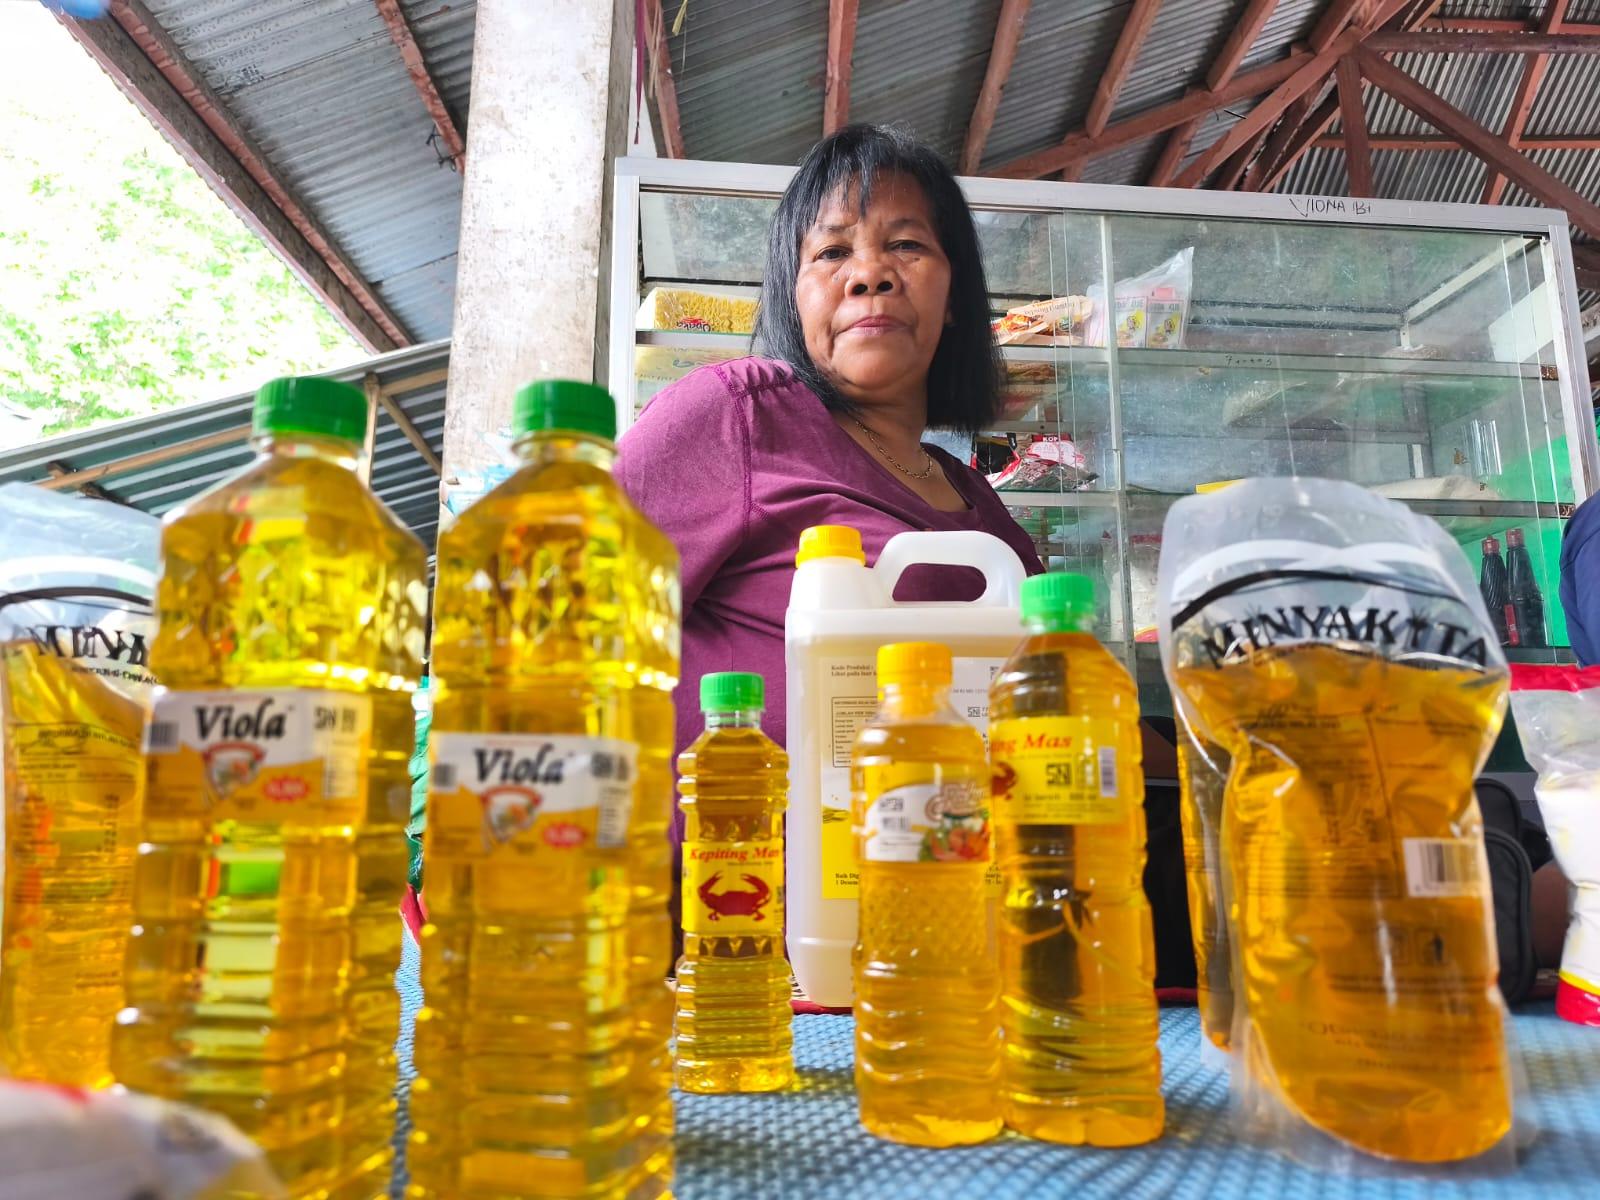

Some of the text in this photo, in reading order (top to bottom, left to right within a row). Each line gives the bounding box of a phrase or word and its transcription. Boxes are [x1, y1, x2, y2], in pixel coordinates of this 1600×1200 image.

[1289, 198, 1346, 218] VIONA
[1202, 604, 1487, 670] MINYAKITA
[195, 697, 287, 741] Viola
[1023, 734, 1073, 750] Mas
[473, 742, 565, 785] Viola
[1046, 763, 1072, 787] SNI
[690, 848, 750, 863] Kepiting
